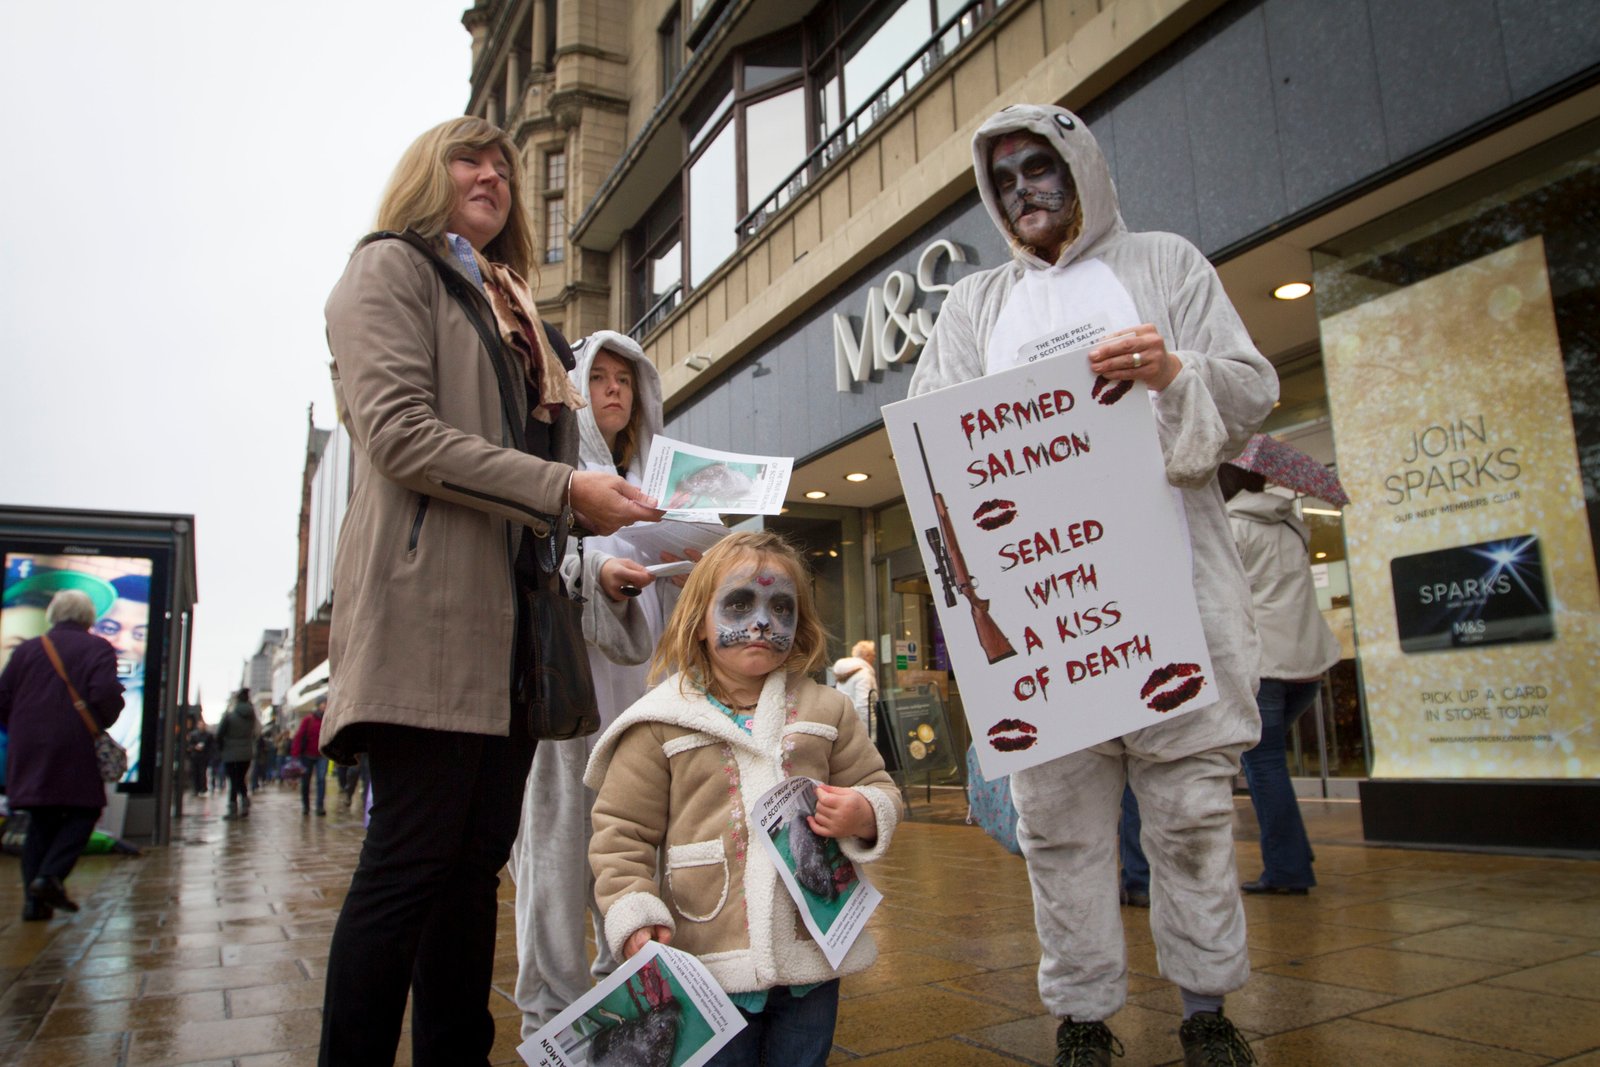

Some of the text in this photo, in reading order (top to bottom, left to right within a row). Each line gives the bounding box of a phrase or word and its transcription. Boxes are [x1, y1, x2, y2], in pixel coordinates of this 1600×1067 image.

[833, 239, 965, 392] M&S
[1028, 326, 1106, 362] OF SCOTTISH SALMON
[1035, 323, 1093, 351] THE TRUE PRICE
[961, 389, 1075, 448] FARMED
[1403, 415, 1487, 464] JOIN
[967, 432, 1091, 489] SALMON
[1384, 447, 1521, 505] SPARKS
[1415, 507, 1438, 519] NEW
[1440, 497, 1489, 513] MEMBERS
[999, 519, 1104, 571] SEALED
[1025, 563, 1098, 609] WITH
[1419, 574, 1511, 605] SPARKS
[1024, 600, 1122, 656] A KISS
[1453, 619, 1486, 635] M&S
[1013, 634, 1152, 701] OF DEATH
[1422, 685, 1548, 704] PICK UP A CARD
[1425, 704, 1549, 722] IN STORE TODAY
[760, 816, 768, 827] OF
[767, 791, 792, 819] SCOTTISH
[763, 795, 775, 810] THE
[774, 783, 789, 799] TRUE
